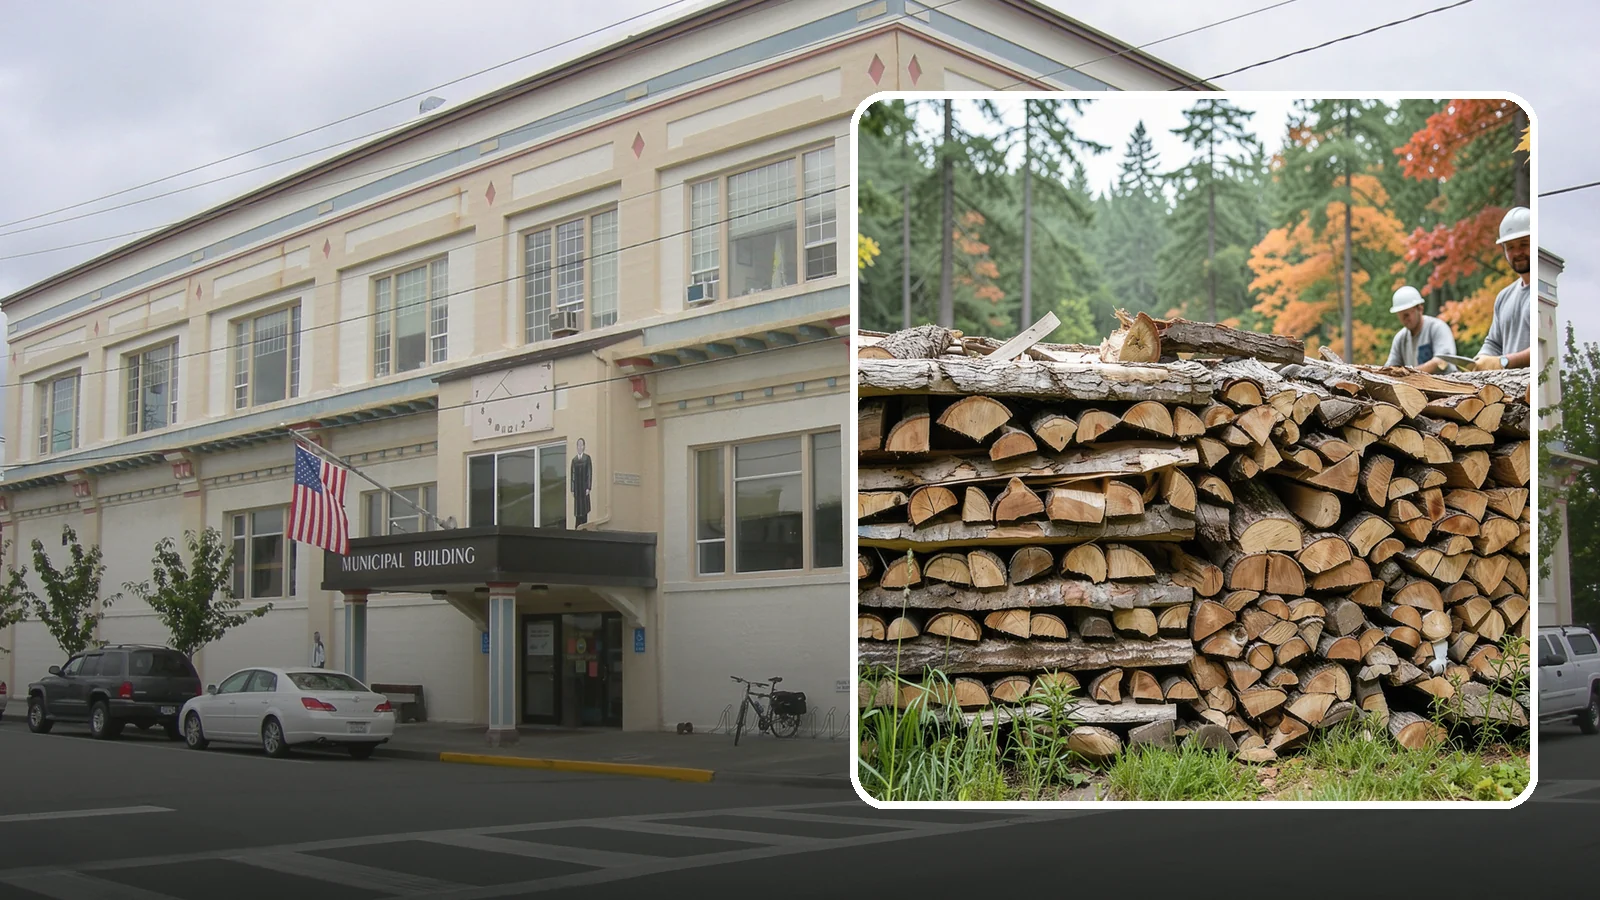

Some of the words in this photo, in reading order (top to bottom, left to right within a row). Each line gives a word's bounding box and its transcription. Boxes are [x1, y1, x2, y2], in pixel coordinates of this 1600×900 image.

[488, 418, 492, 426] 9
[494, 424, 500, 432] 10
[502, 426, 506, 434] 11
[342, 552, 405, 572] MUNICIPAL
[414, 546, 475, 567] BUILDING
